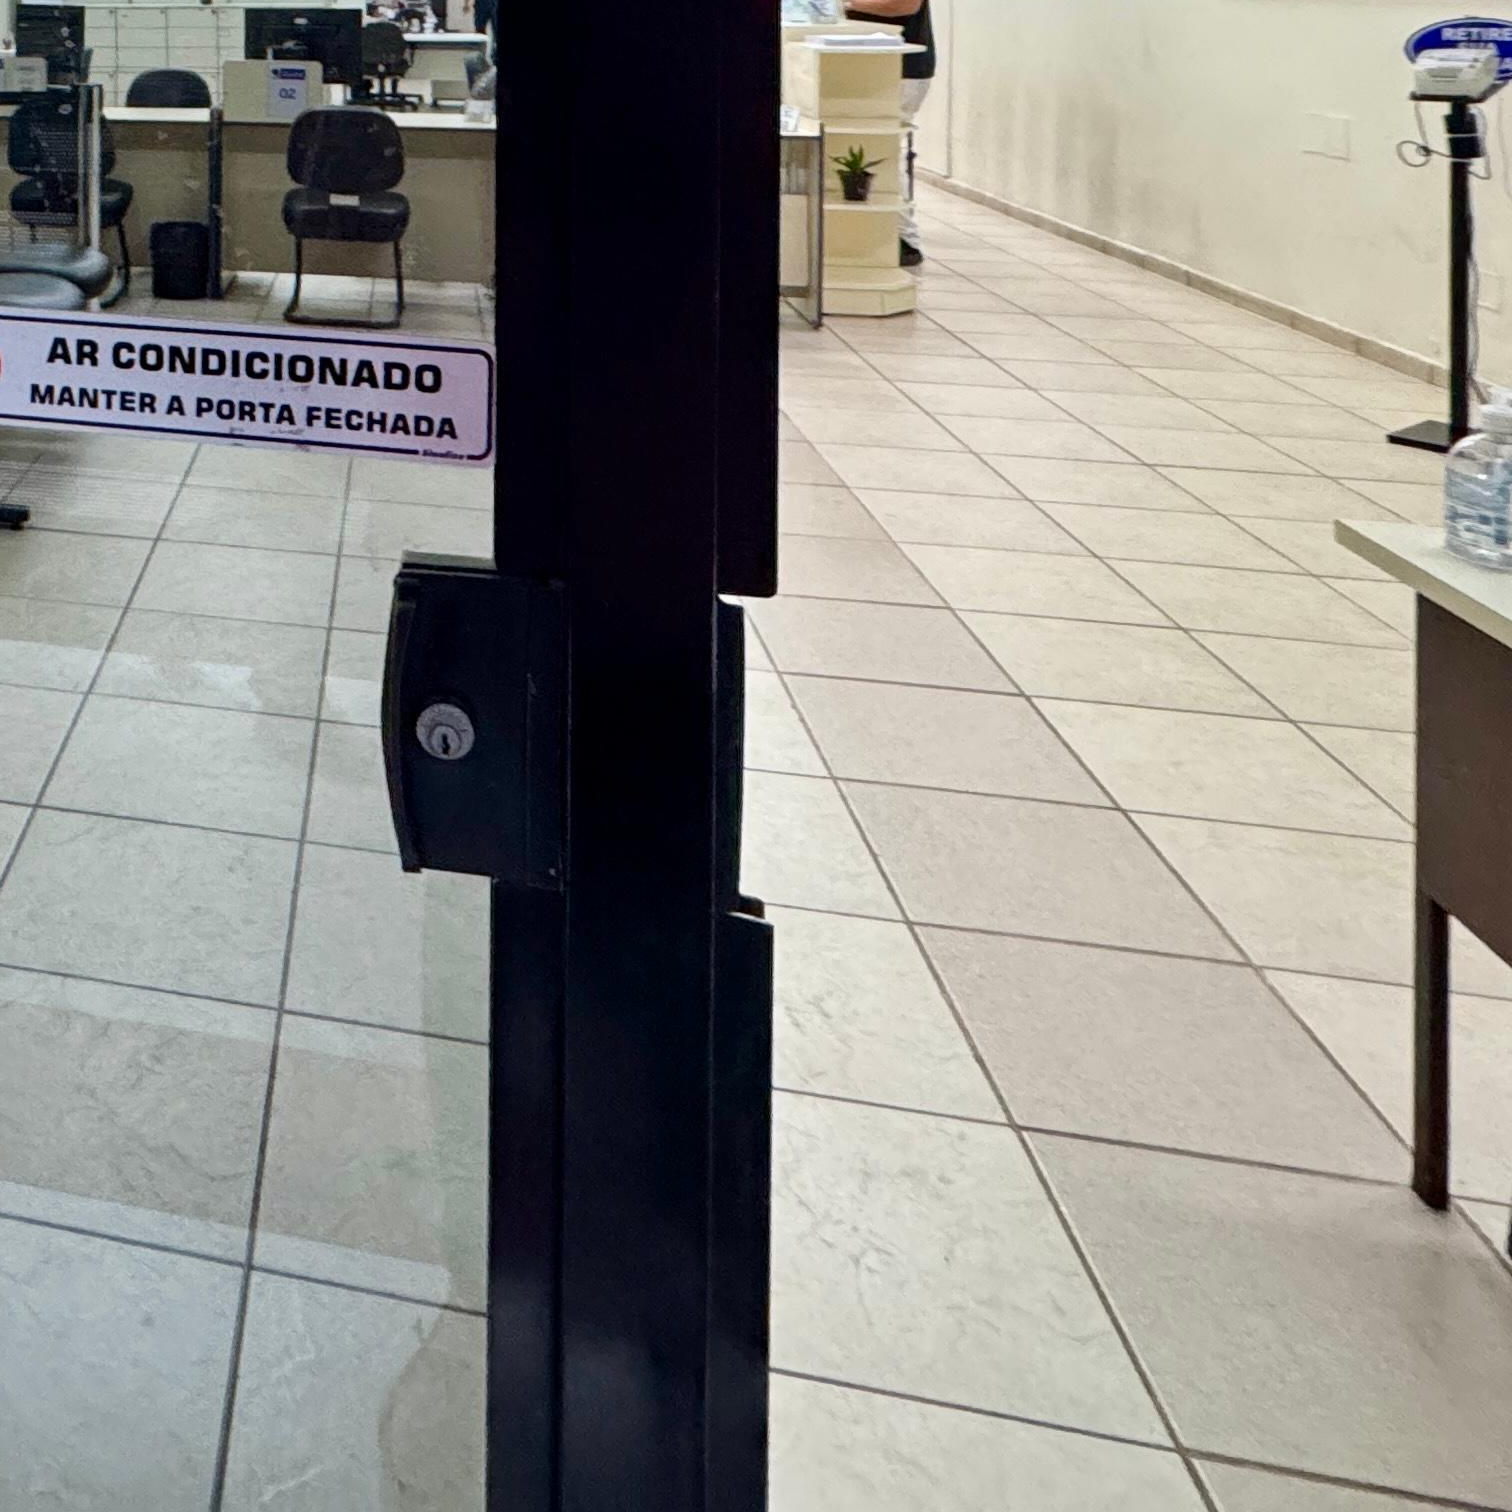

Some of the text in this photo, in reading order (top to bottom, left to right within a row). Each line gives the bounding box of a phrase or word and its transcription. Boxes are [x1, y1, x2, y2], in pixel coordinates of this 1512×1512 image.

[47, 336, 443, 394] AR CONDICIONADO
[29, 382, 459, 440] MANTER A PORTA FECHADA
